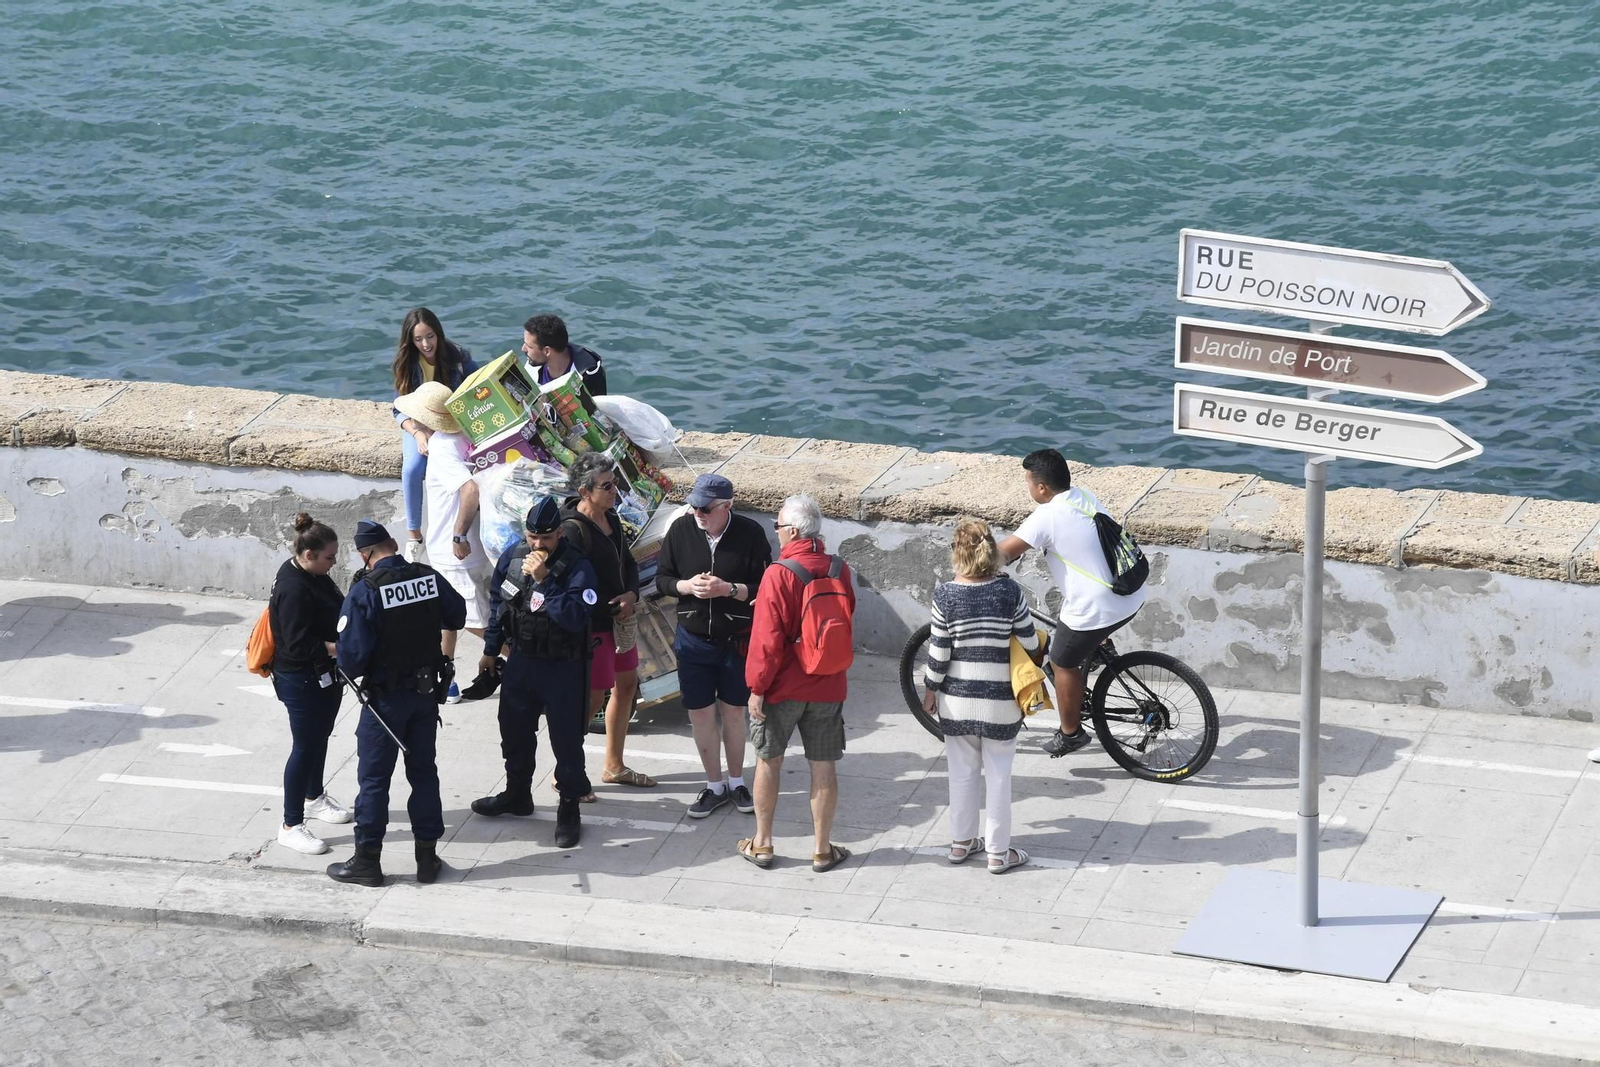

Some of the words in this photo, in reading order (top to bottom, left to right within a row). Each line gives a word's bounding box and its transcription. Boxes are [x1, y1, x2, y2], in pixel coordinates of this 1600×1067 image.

[1197, 246, 1254, 271] RUE
[1196, 271, 1233, 292] DU
[1239, 277, 1355, 308] POISSON
[1361, 293, 1427, 318] NOIR
[1193, 336, 1262, 362] Jardin
[1269, 345, 1297, 366] de
[1304, 349, 1353, 374] Port
[1198, 399, 1248, 423] Rue
[1255, 407, 1286, 429] de
[1294, 412, 1382, 442] Berger
[385, 578, 436, 606] POLICE
[503, 581, 518, 595] POLICE
